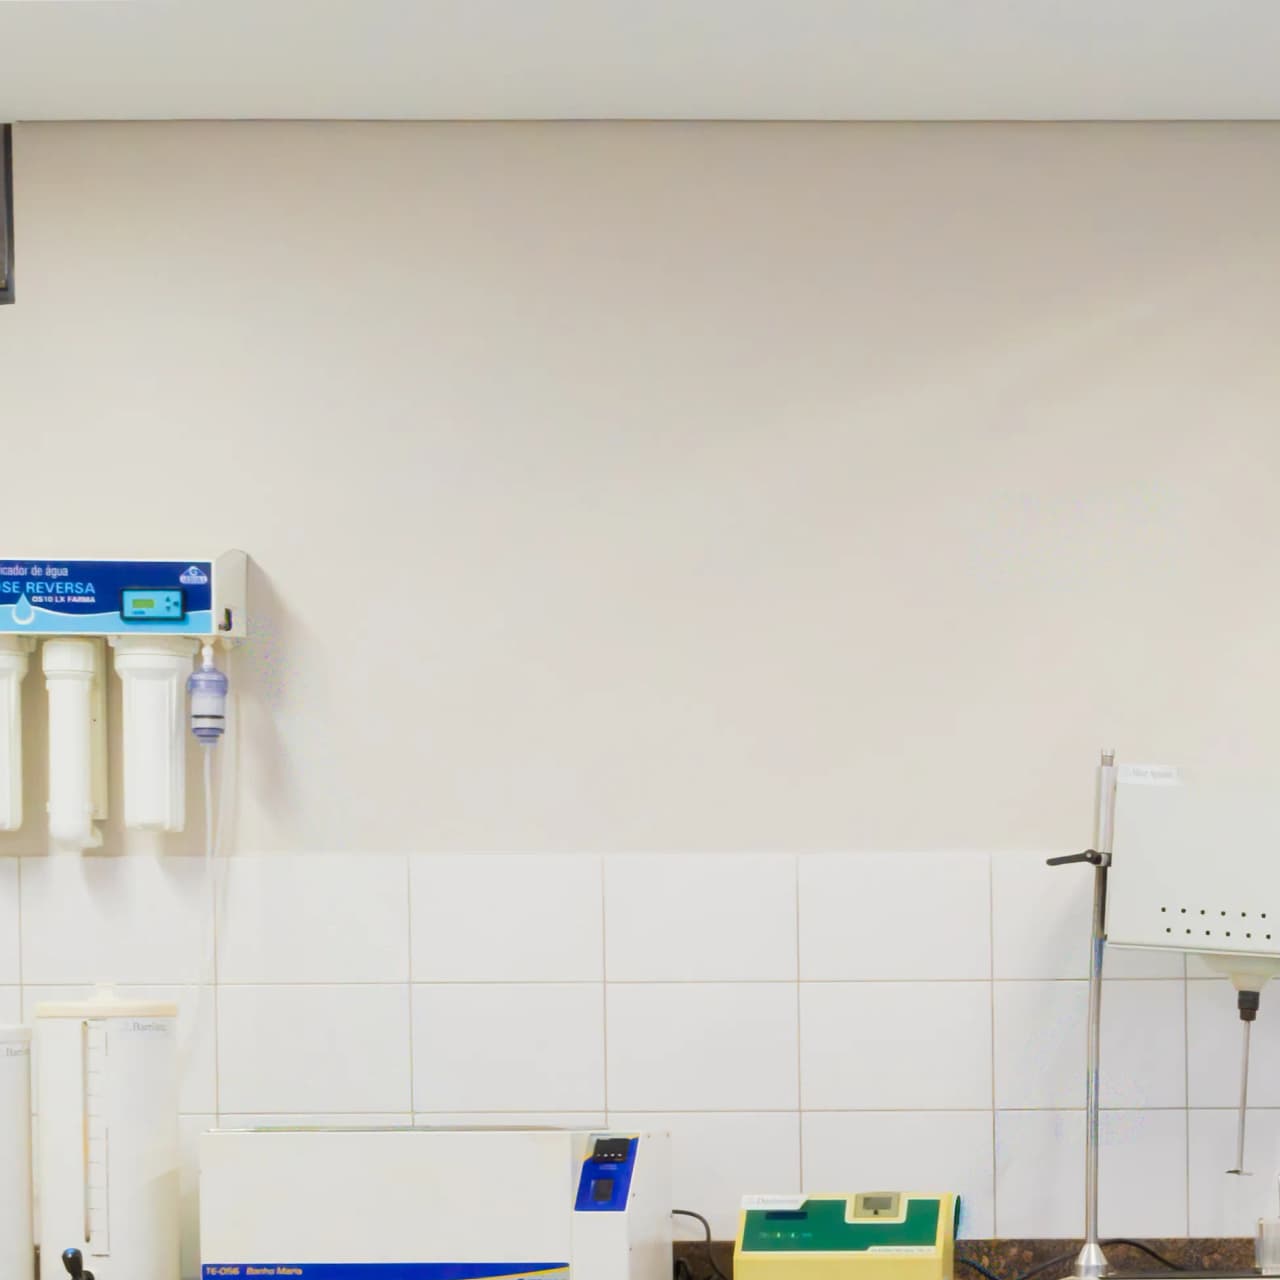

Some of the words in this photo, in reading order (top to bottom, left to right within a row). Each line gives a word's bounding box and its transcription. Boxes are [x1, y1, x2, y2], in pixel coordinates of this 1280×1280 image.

[31, 564, 43, 577] de
[46, 564, 69, 578] água
[0, 581, 20, 594] SE
[26, 581, 95, 594] REVERSA
